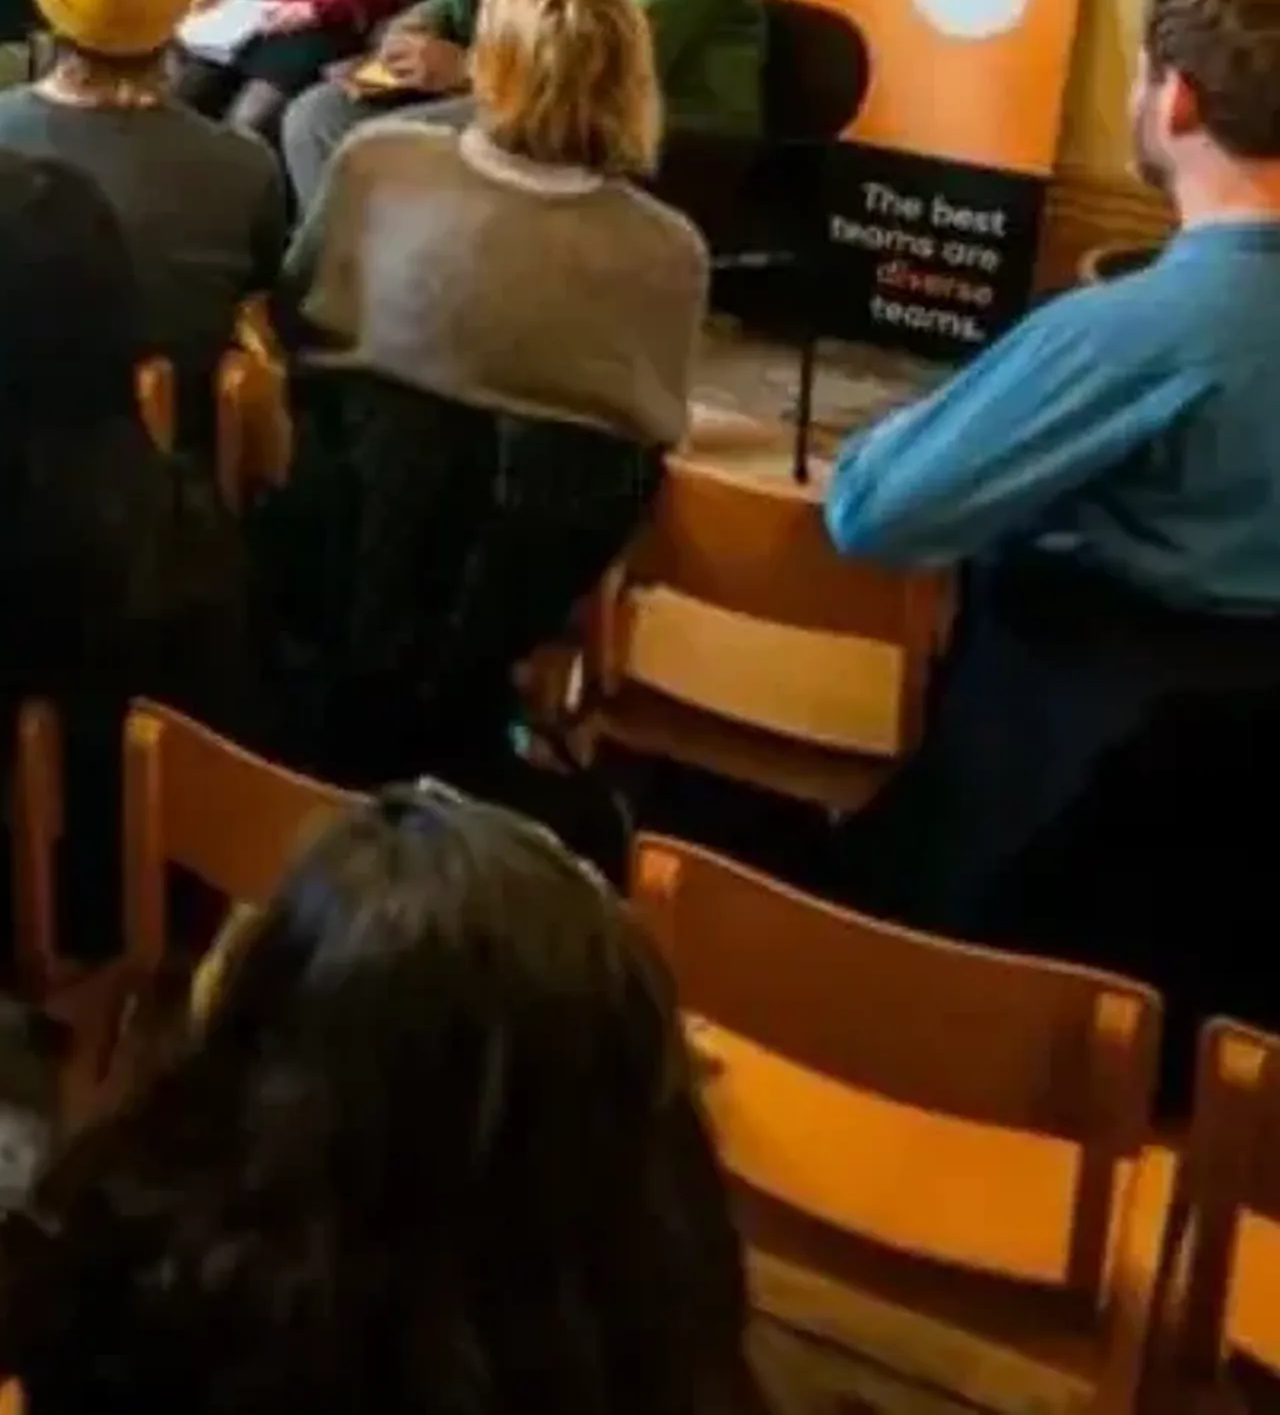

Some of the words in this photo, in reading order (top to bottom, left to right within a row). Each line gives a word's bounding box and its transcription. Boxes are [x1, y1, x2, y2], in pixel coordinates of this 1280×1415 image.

[862, 182, 923, 221] The
[932, 194, 1005, 236] best
[829, 215, 934, 258] teams
[942, 241, 1000, 272] are
[876, 262, 993, 306] diverse
[870, 296, 985, 342] teams.
